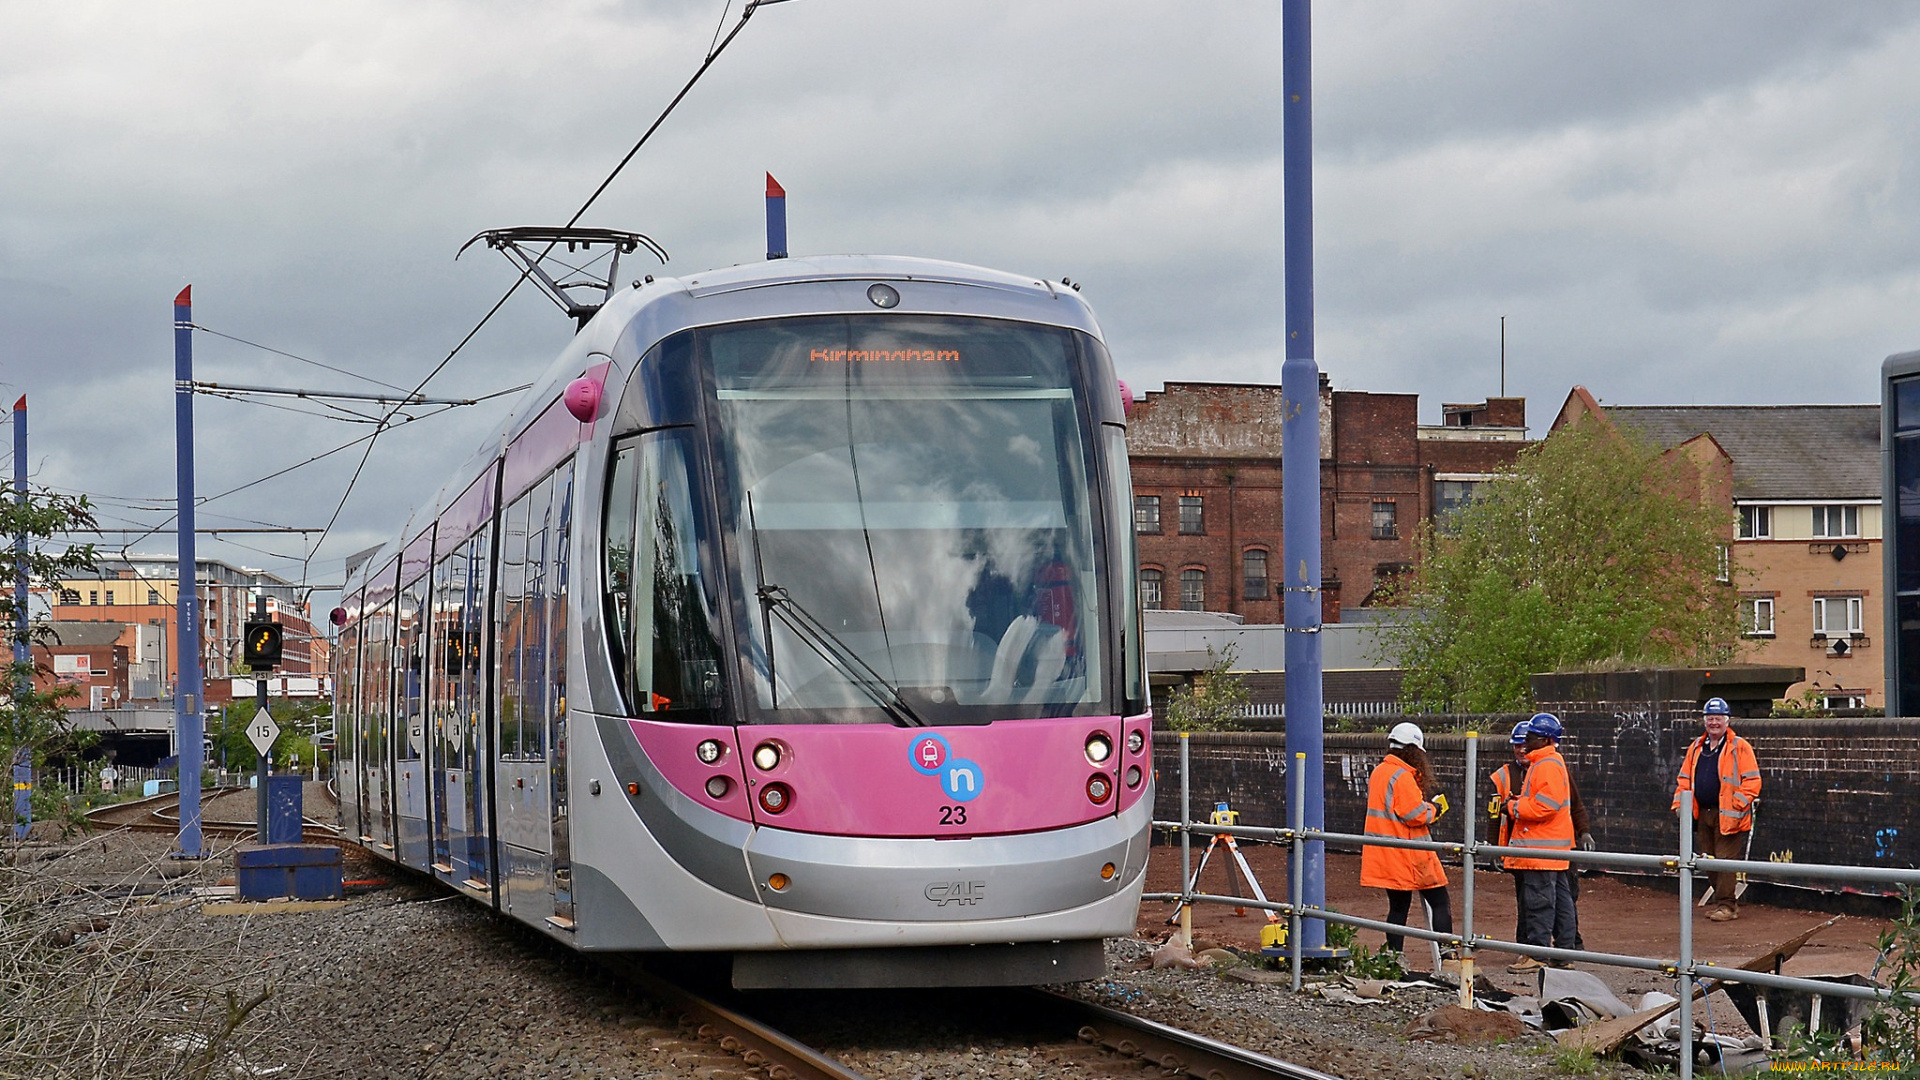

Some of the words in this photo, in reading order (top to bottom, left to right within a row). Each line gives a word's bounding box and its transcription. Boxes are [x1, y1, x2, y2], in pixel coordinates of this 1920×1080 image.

[255, 725, 270, 738] 15
[949, 768, 975, 792] n
[938, 805, 967, 825] 23
[924, 880, 986, 907] CAF
